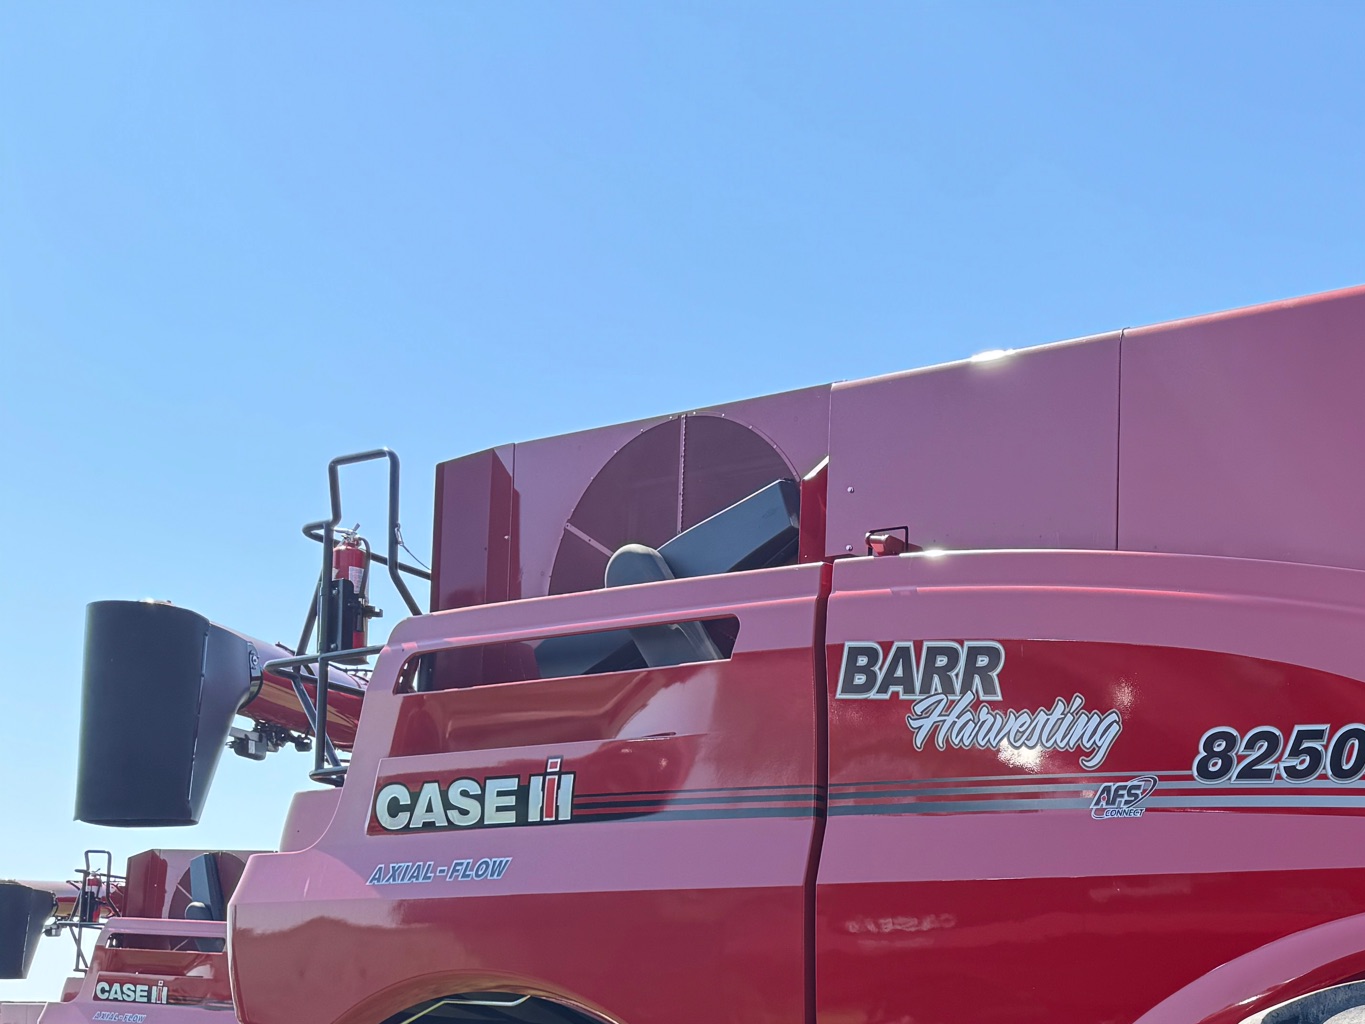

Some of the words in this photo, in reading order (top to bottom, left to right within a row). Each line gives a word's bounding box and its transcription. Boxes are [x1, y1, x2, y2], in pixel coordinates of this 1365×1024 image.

[835, 641, 1005, 700] BARR
[906, 692, 1122, 770] Harvesting
[375, 775, 517, 831] CASE
[1090, 783, 1145, 808] AFS
[1104, 808, 1145, 818] CONNECT
[96, 981, 149, 1002] CASE
